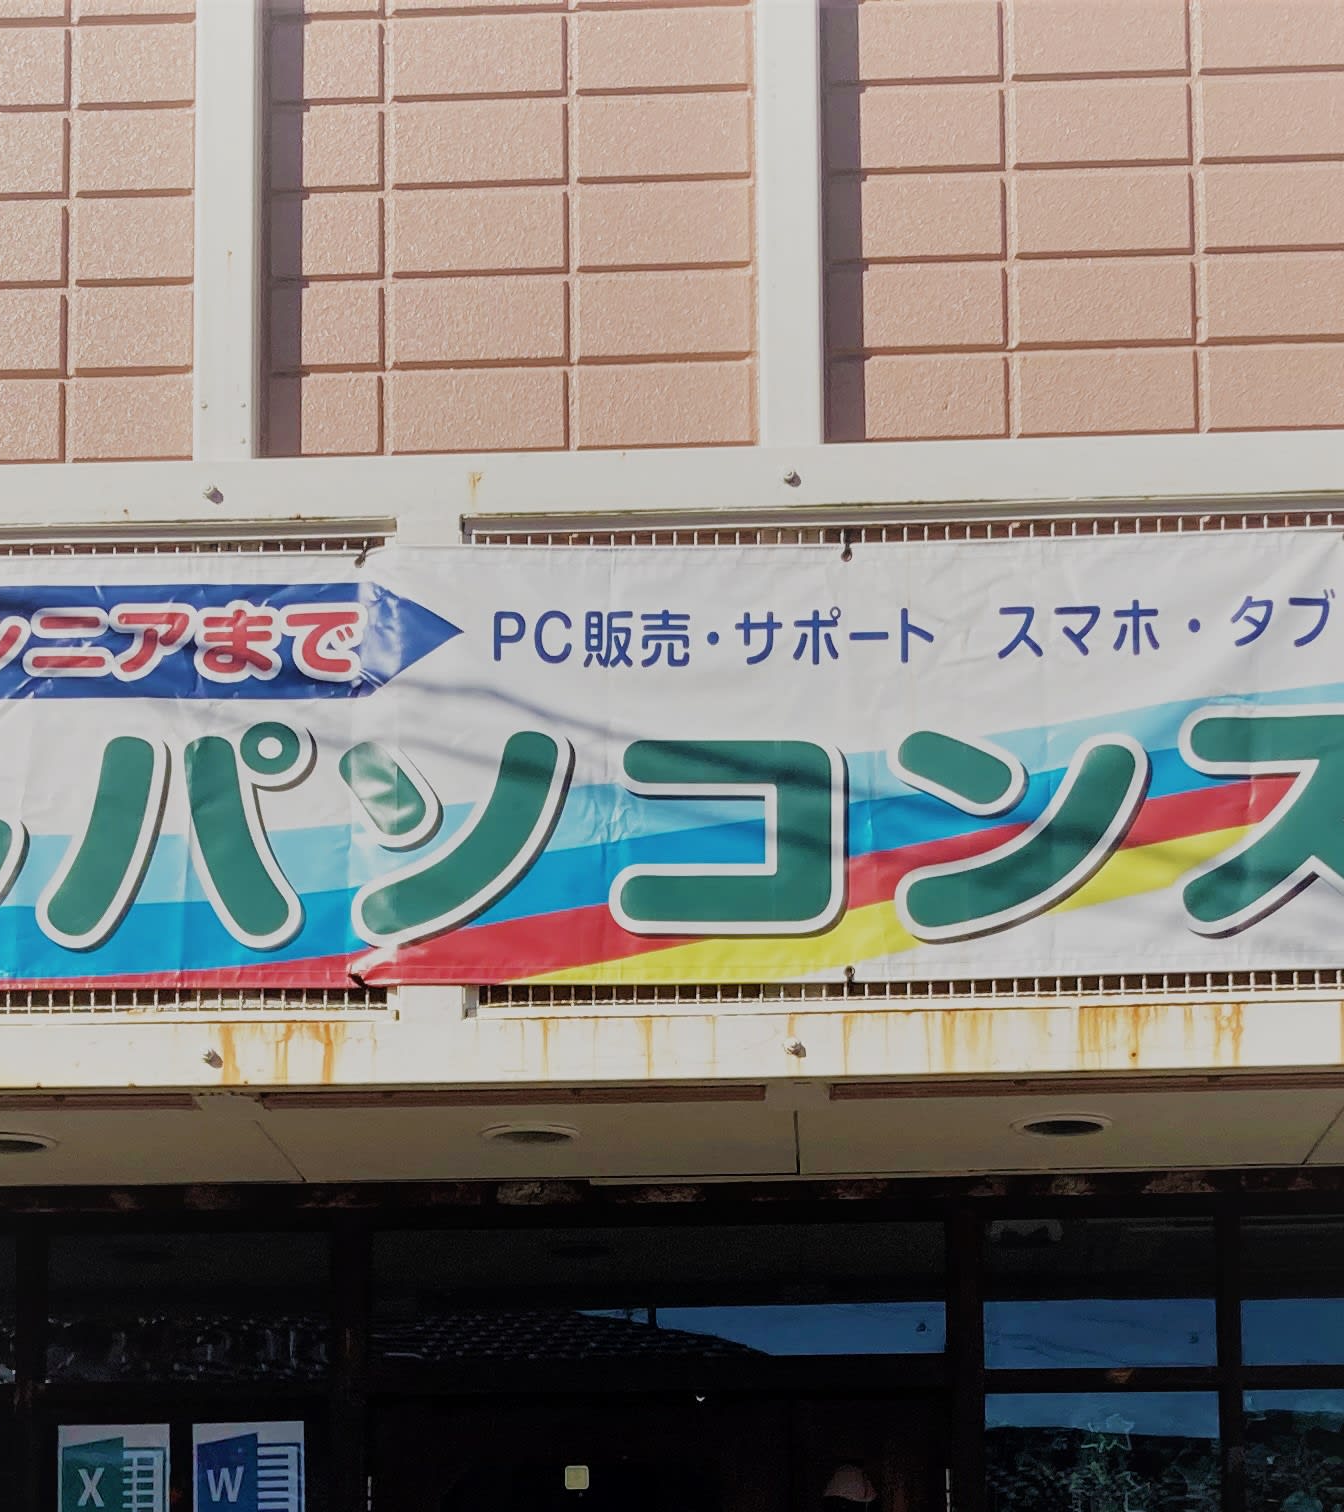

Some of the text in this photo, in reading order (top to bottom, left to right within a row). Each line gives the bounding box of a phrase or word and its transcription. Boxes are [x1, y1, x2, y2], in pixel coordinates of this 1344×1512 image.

[493, 607, 934, 669] PC販売・サポート
[206, 1465, 245, 1504] W
